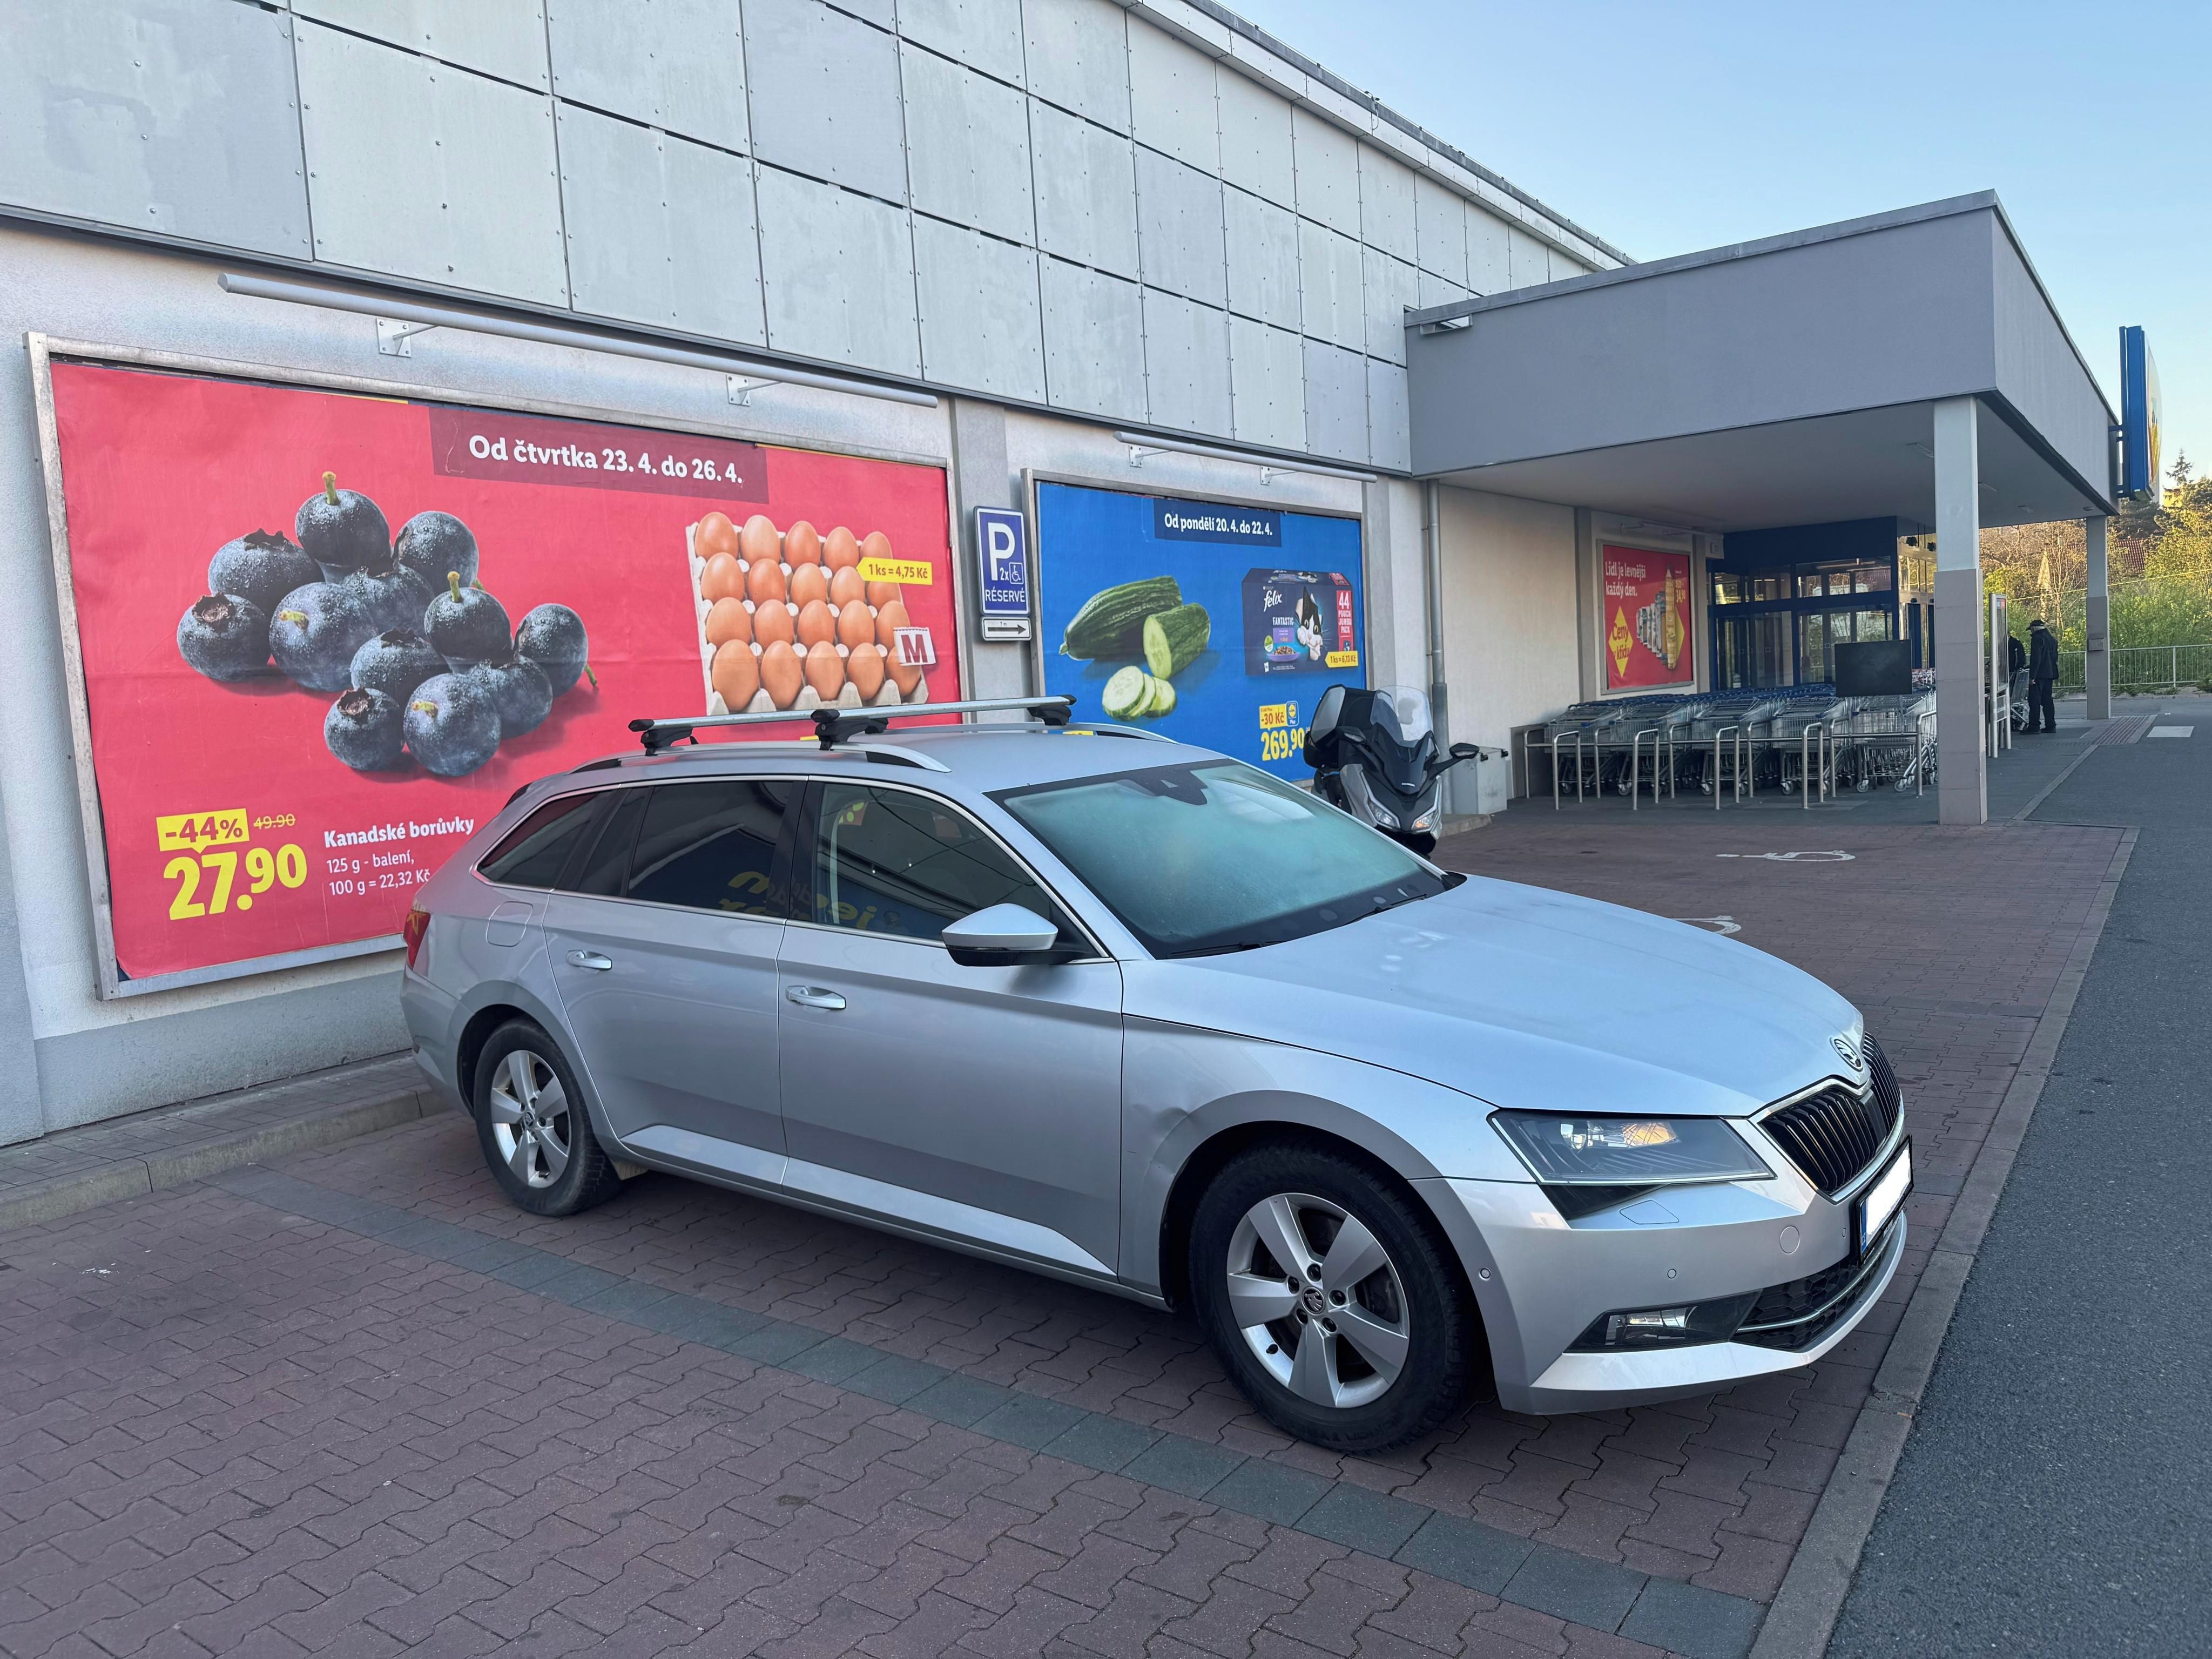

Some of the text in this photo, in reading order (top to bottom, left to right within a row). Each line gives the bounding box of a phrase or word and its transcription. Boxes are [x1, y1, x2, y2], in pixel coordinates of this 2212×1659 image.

[469, 435, 743, 484] Od čtvrtka 23. 4. do 26. 4.
[1164, 513, 1179, 529] Od
[1180, 516, 1215, 532] pondělí
[1216, 518, 1230, 532] 20.
[1239, 520, 1251, 534] do
[1251, 521, 1264, 535] 22.
[988, 522, 1015, 581] P
[868, 563, 873, 575] 1
[875, 564, 887, 576] ks
[895, 565, 915, 579] 4,75
[917, 568, 928, 579] Kč
[1000, 567, 1009, 581] 2x
[1605, 561, 1646, 582] Lidl je levnější
[985, 586, 1026, 602] RÉSERVÉ
[1339, 591, 1350, 610] 44
[1605, 581, 1637, 599] každý den.
[1264, 590, 1283, 612] felix
[1272, 617, 1294, 626] FANTASTIC
[1612, 623, 1629, 643] Ceny
[901, 634, 928, 663] M
[1333, 655, 1338, 664] ks
[1350, 655, 1357, 663] Kč
[1261, 711, 1284, 725] -30 Kč
[1261, 727, 1305, 761] 269.90
[165, 816, 243, 843] -44%
[253, 813, 296, 830] 49.90
[323, 815, 474, 848] Kanadské borůvky
[326, 858, 348, 874] 125
[352, 859, 360, 874] g
[372, 849, 415, 868] balení,
[163, 843, 307, 921] 27.90
[329, 879, 353, 896] 100
[357, 880, 366, 895] g
[379, 871, 413, 889] 22,32
[416, 868, 431, 884] Kč
